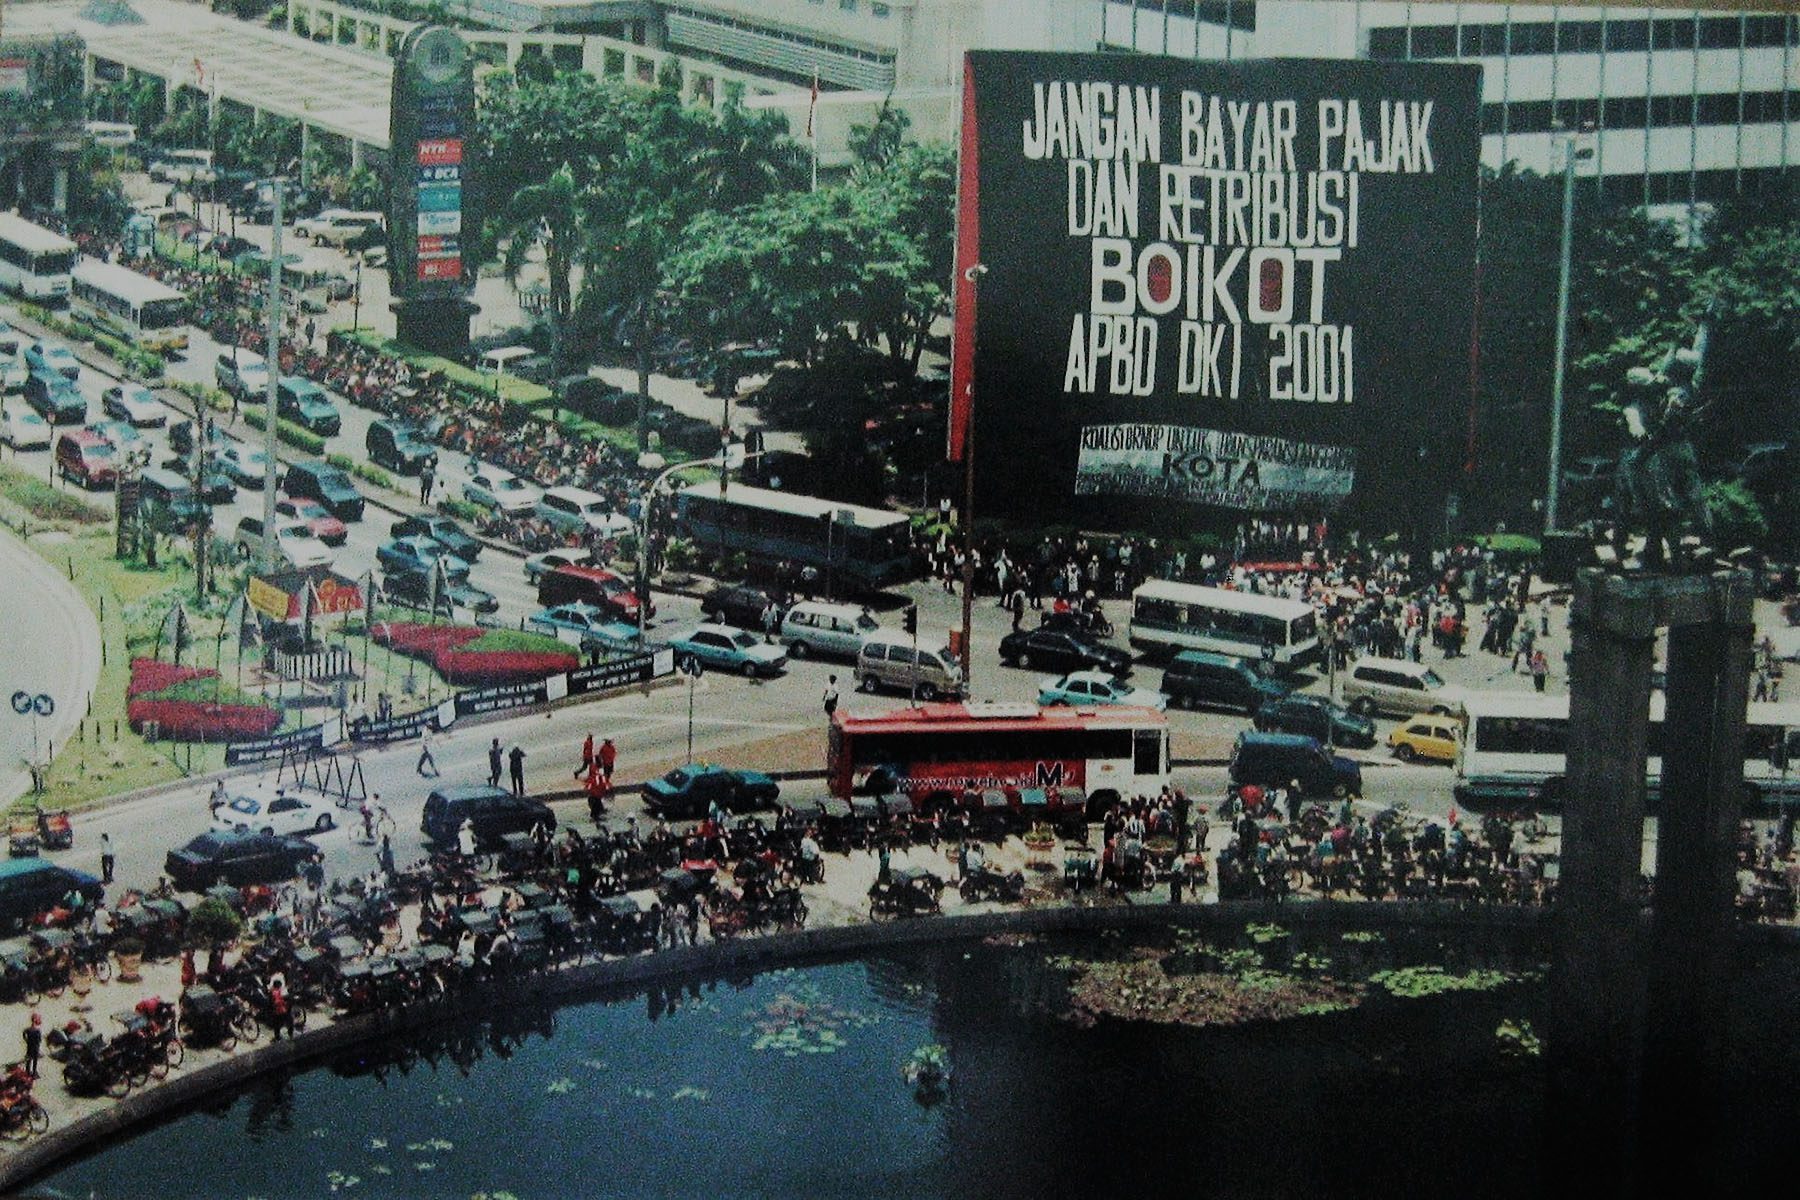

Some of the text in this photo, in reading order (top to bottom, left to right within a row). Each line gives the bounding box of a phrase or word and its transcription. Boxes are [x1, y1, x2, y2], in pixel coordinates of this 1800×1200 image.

[1023, 81, 1434, 173] JANGAN BAYAR PAJAK
[1068, 158, 1359, 248] DAN RETRIBUSI
[1091, 237, 1342, 325] BOIKOT
[1063, 313, 1354, 403] APBD DKI 2001
[1162, 453, 1260, 488] KOTA
